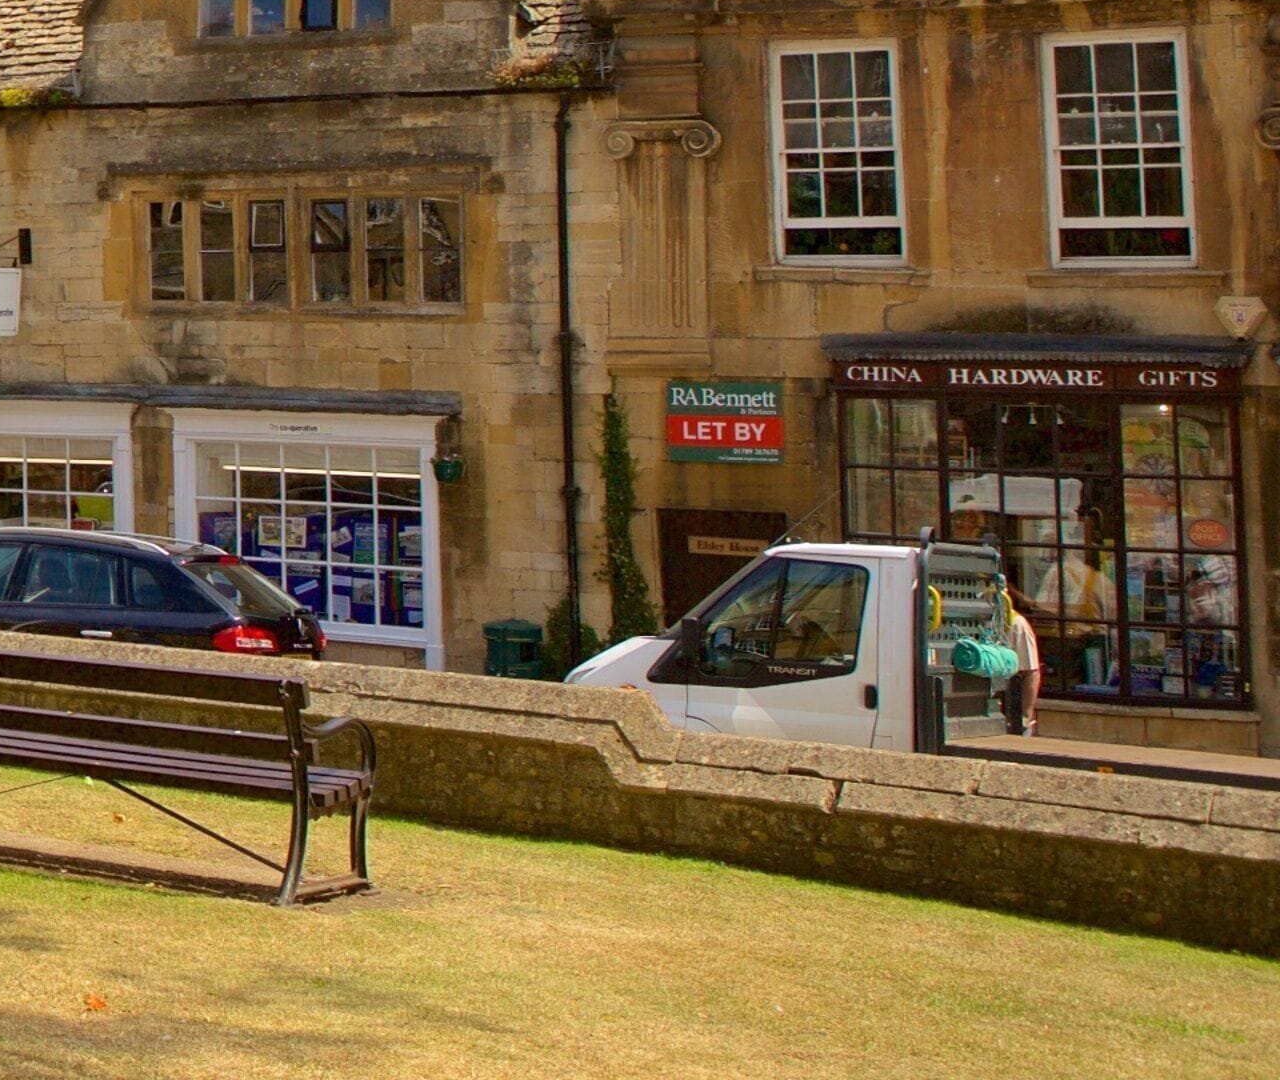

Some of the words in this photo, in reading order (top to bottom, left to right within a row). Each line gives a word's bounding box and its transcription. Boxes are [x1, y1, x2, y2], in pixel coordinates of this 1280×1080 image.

[846, 366, 922, 382] CHINA
[949, 368, 1104, 385] HARDWARE
[1138, 369, 1217, 387] GIFTS
[280, 424, 318, 432] co-operative
[683, 421, 727, 440] LET
[734, 422, 766, 441] BY
[729, 541, 760, 553] House
[767, 666, 817, 676] TRANSIT
